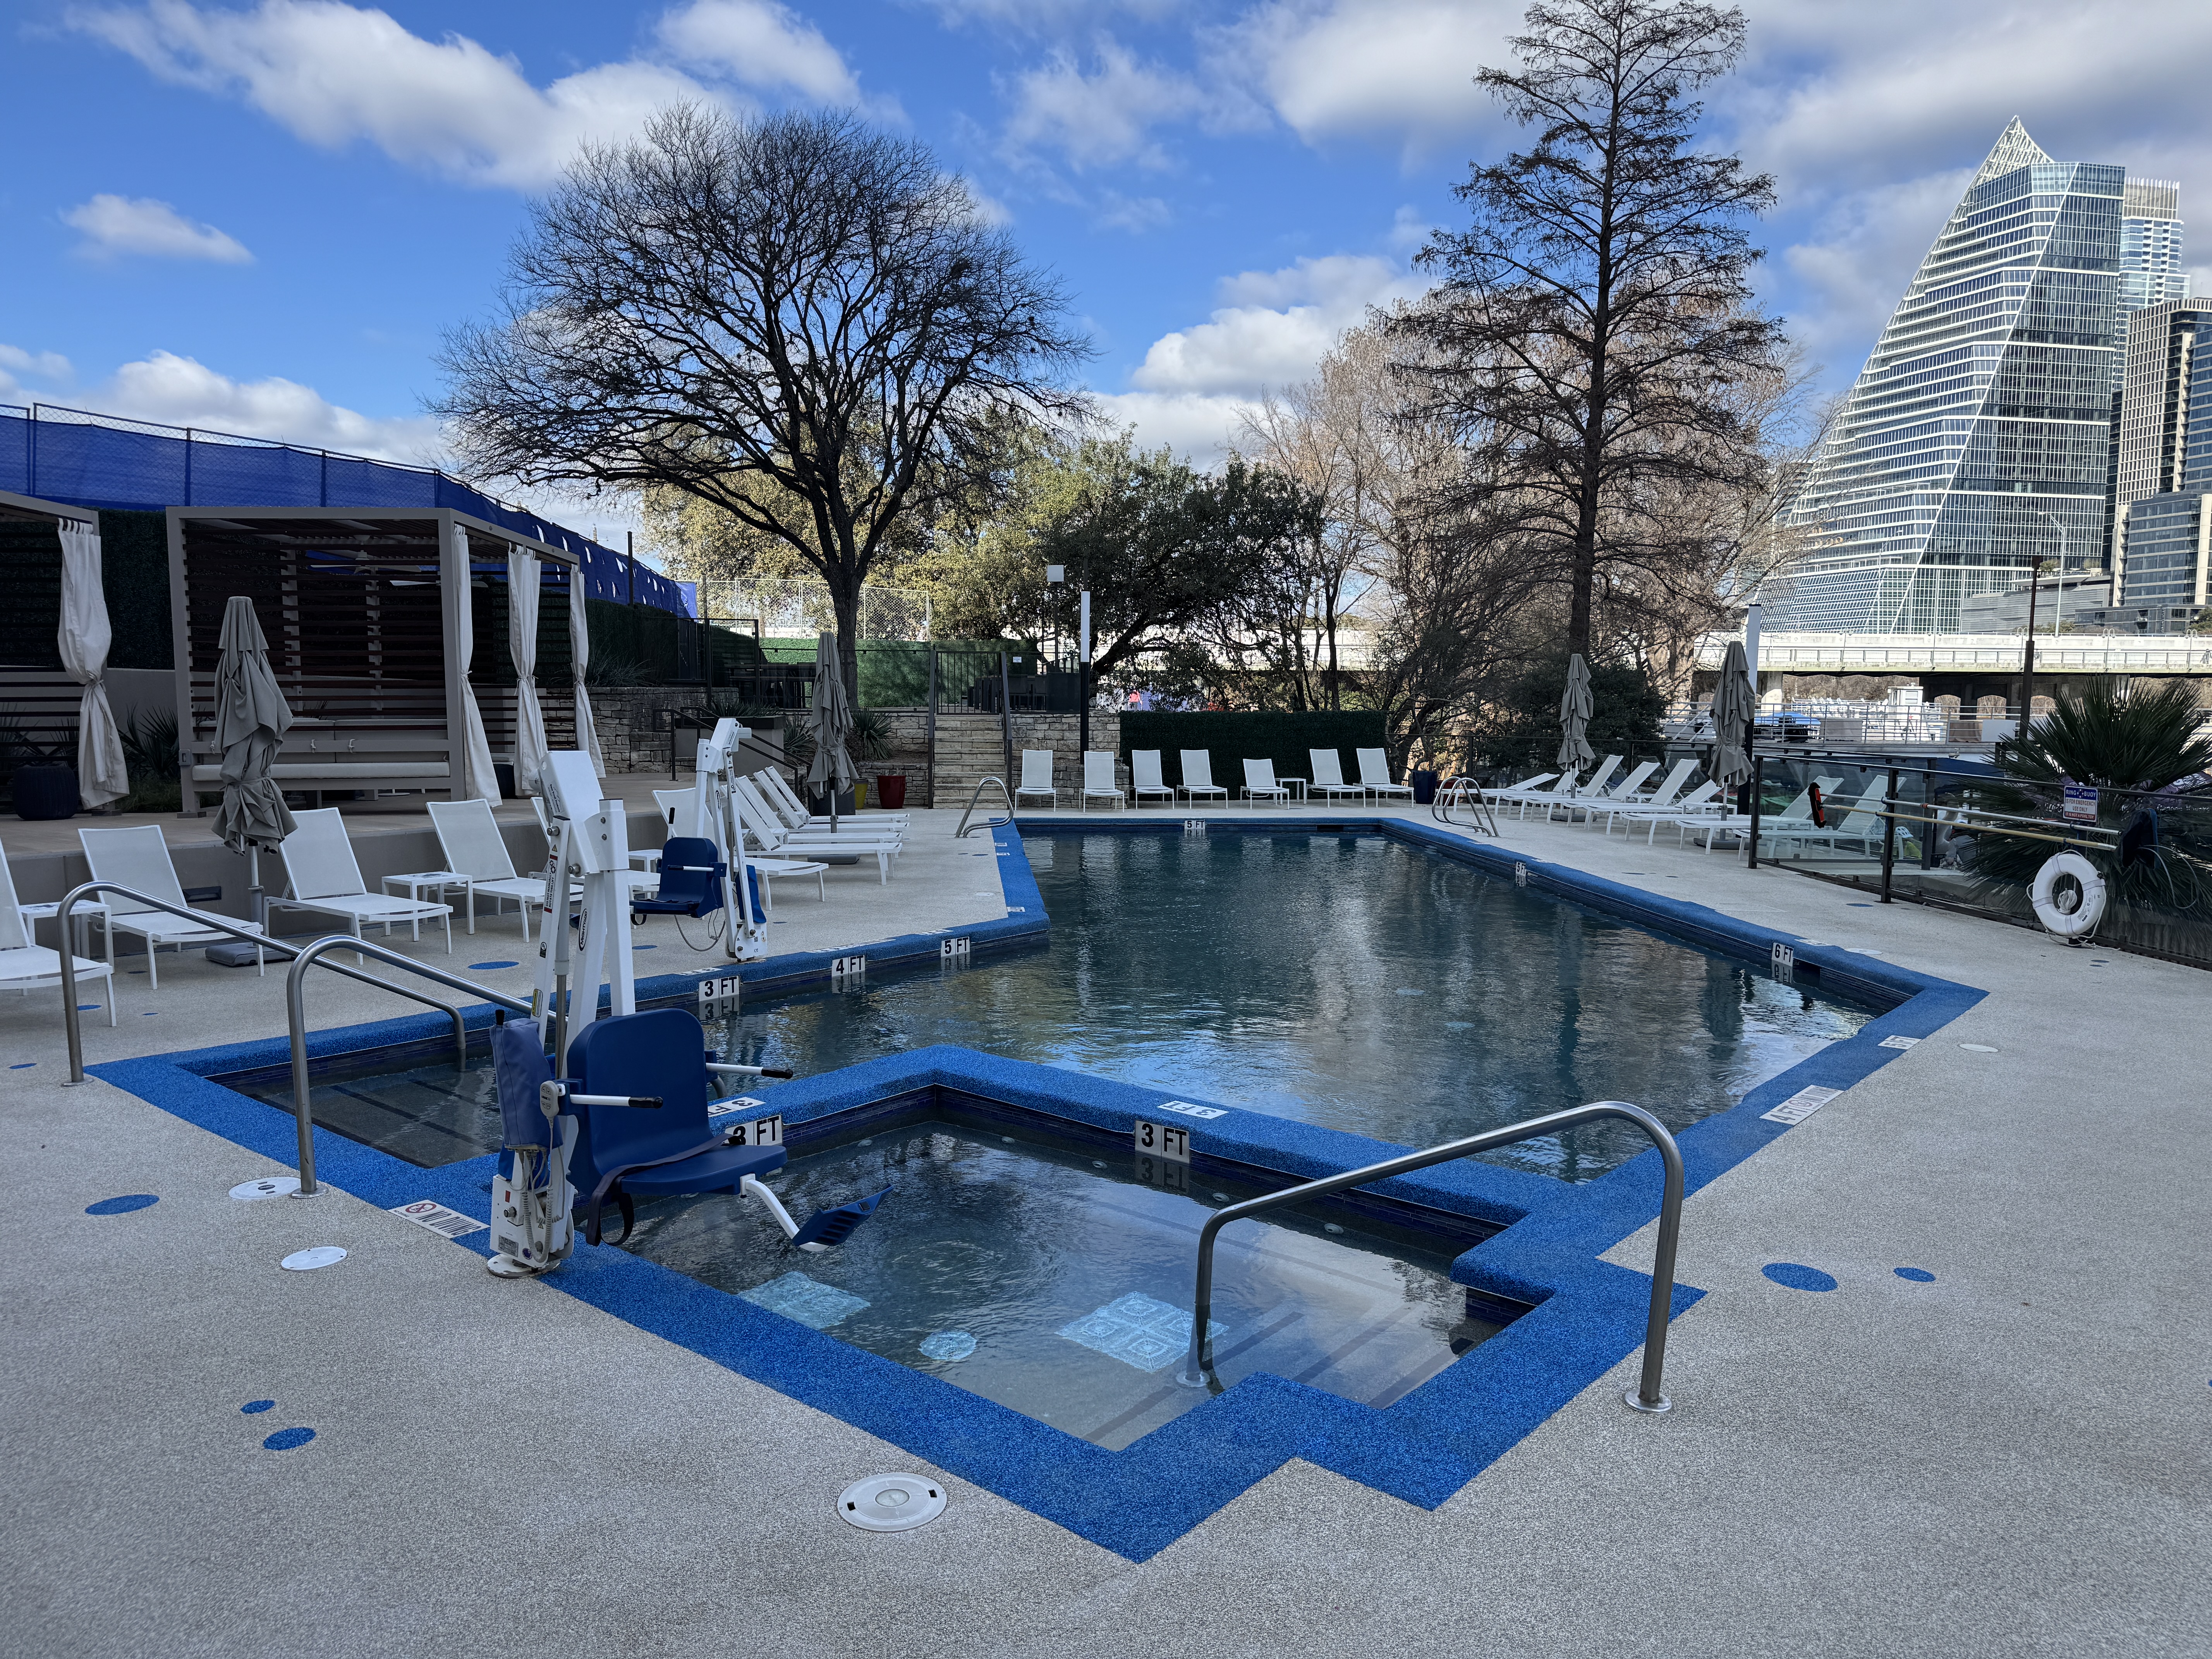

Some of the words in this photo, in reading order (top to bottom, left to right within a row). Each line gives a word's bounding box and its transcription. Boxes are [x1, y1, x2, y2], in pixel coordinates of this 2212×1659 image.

[1517, 862, 1520, 872] 5
[1521, 864, 1526, 874] FT
[945, 940, 951, 954] 5
[957, 937, 968, 953] FT
[1775, 944, 1781, 958] 6
[1783, 946, 1793, 962] FT
[836, 959, 844, 974] 4
[850, 955, 864, 972] FT
[704, 981, 714, 997] 3
[721, 976, 737, 994] FT
[1162, 1102, 1196, 1111] FT
[1777, 1106, 1808, 1116] FT
[757, 1116, 779, 1145] FT
[1141, 1123, 1154, 1147] 3
[1164, 1127, 1187, 1156] FT
[415, 1210, 452, 1222] NO
[429, 1216, 482, 1236] DIVING
